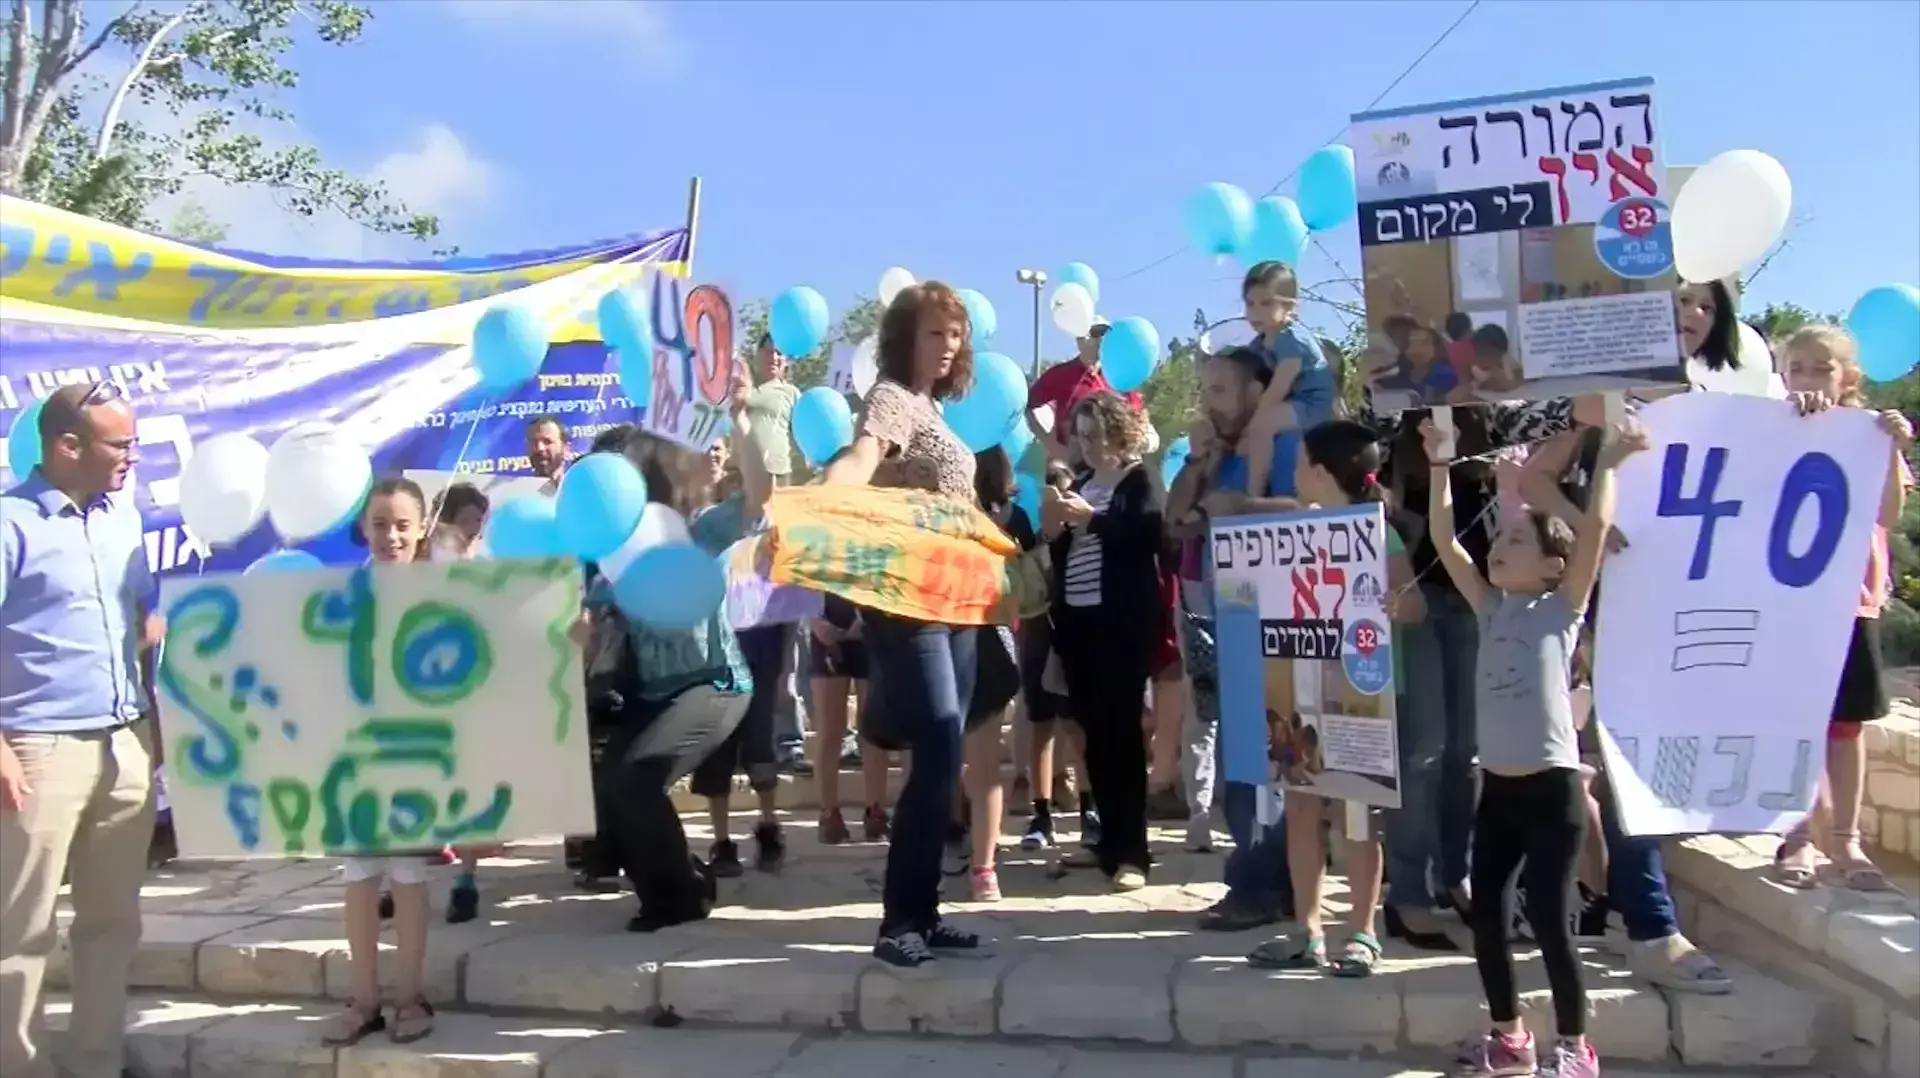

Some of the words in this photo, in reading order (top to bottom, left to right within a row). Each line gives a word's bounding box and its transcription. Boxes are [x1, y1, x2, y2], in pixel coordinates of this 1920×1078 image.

[1438, 93, 1653, 168] המורה
[1493, 182, 1535, 225] לי
[1538, 145, 1657, 224] אין
[1375, 200, 1478, 245] מקום
[1623, 206, 1653, 229] 32
[651, 269, 733, 405] 40
[1214, 521, 1316, 569] צפופים
[1328, 518, 1378, 563] אם
[1656, 443, 1850, 588] 40
[1291, 546, 1346, 620] לא
[302, 566, 493, 705] 40
[1264, 617, 1341, 657] לומדים
[1356, 628, 1375, 648] 32
[1605, 728, 1812, 812] נכש
